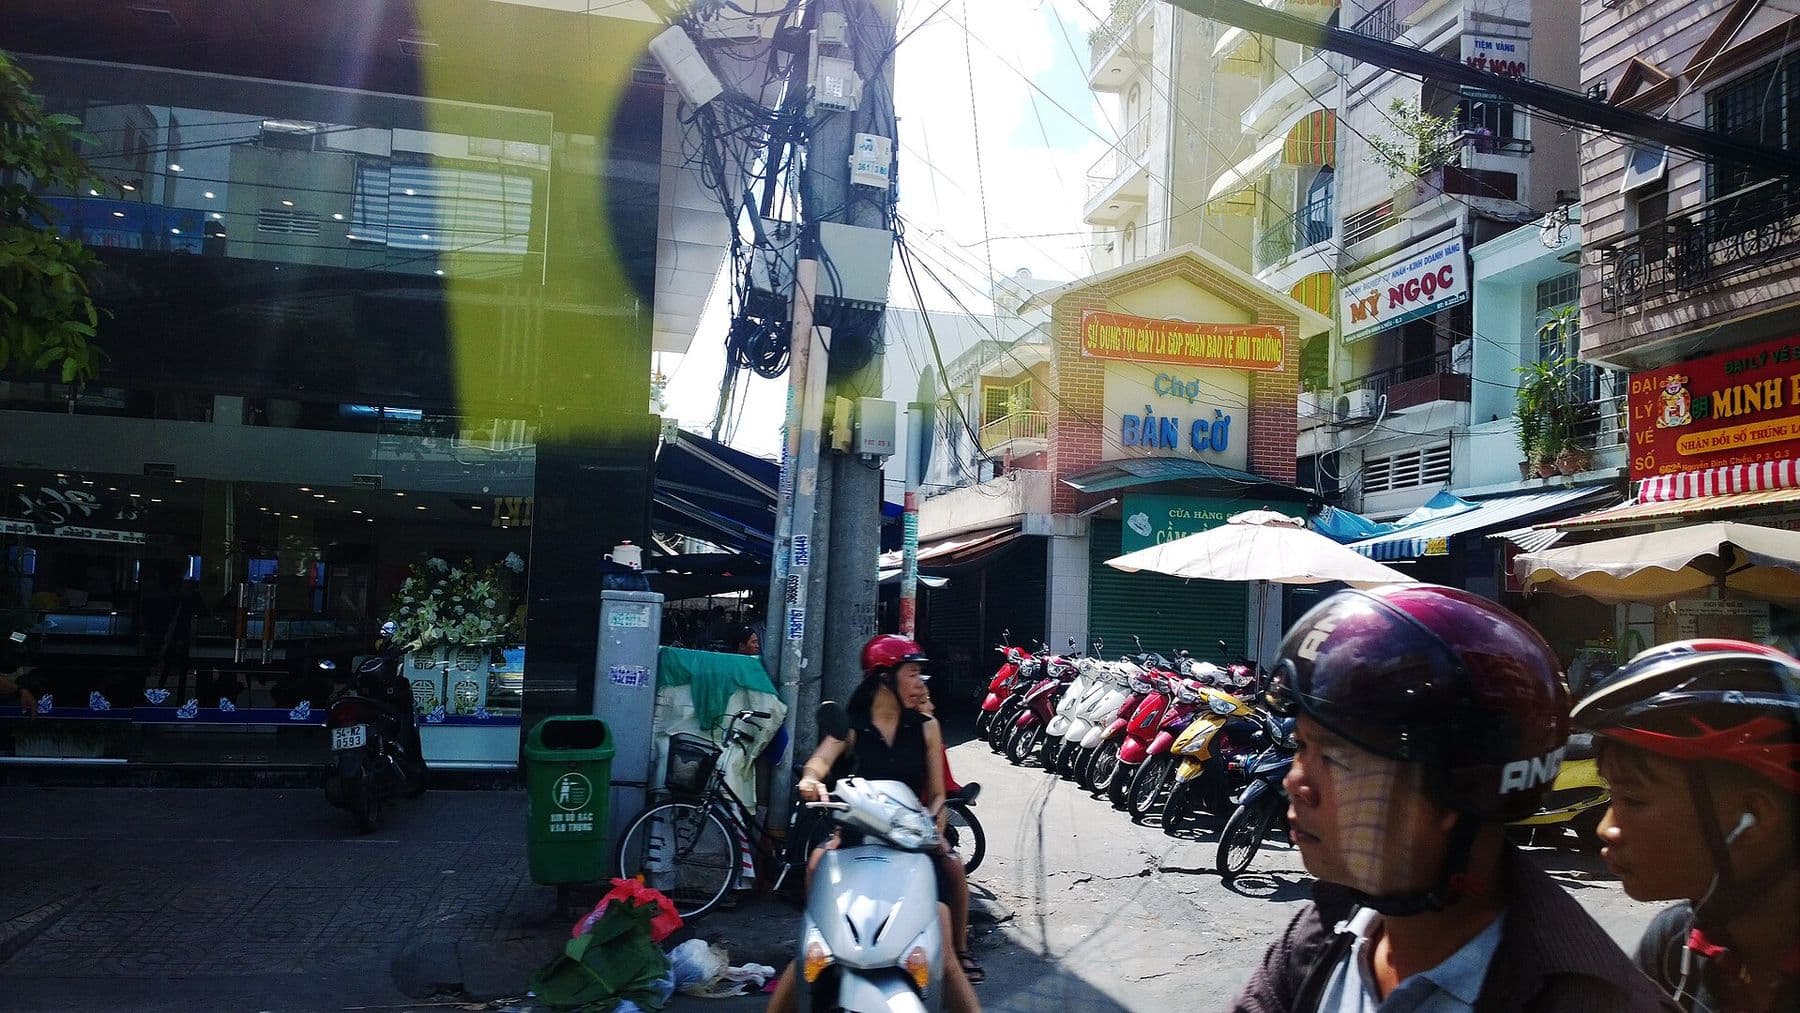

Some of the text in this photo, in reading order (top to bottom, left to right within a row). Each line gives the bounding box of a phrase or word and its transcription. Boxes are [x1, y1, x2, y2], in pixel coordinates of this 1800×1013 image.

[1474, 40, 1516, 53] TIỆM VÀNG
[1349, 265, 1453, 324] MỸ NGỌC
[1087, 315, 1099, 349] SỬ
[1099, 325, 1121, 355] DỤNG
[1122, 322, 1136, 352] TÚI
[1155, 324, 1166, 354] LÀ
[1167, 326, 1184, 356] GÓP
[1184, 324, 1205, 357] PHẦN
[1206, 326, 1223, 358] BẢO
[1223, 330, 1234, 364] VỆ
[1235, 330, 1251, 360] MÔI
[1251, 331, 1281, 363] TRƯỜNG
[1154, 373, 1199, 404] Chợ
[1632, 377, 1657, 395] ĐẠI
[1635, 400, 1654, 419] LÝ
[1712, 378, 1783, 420] MINH
[1122, 404, 1231, 452] BÀN CỜ
[1635, 426, 1655, 445] VÉ
[1680, 437, 1710, 452] NHẬN
[1711, 430, 1731, 447] ĐỔI
[1733, 428, 1748, 443] SỐ
[1635, 449, 1656, 471] SỐ
[1169, 508, 1191, 519] CỬA
[1194, 510, 1223, 520] HÀNG
[336, 736, 361, 748] 0593
